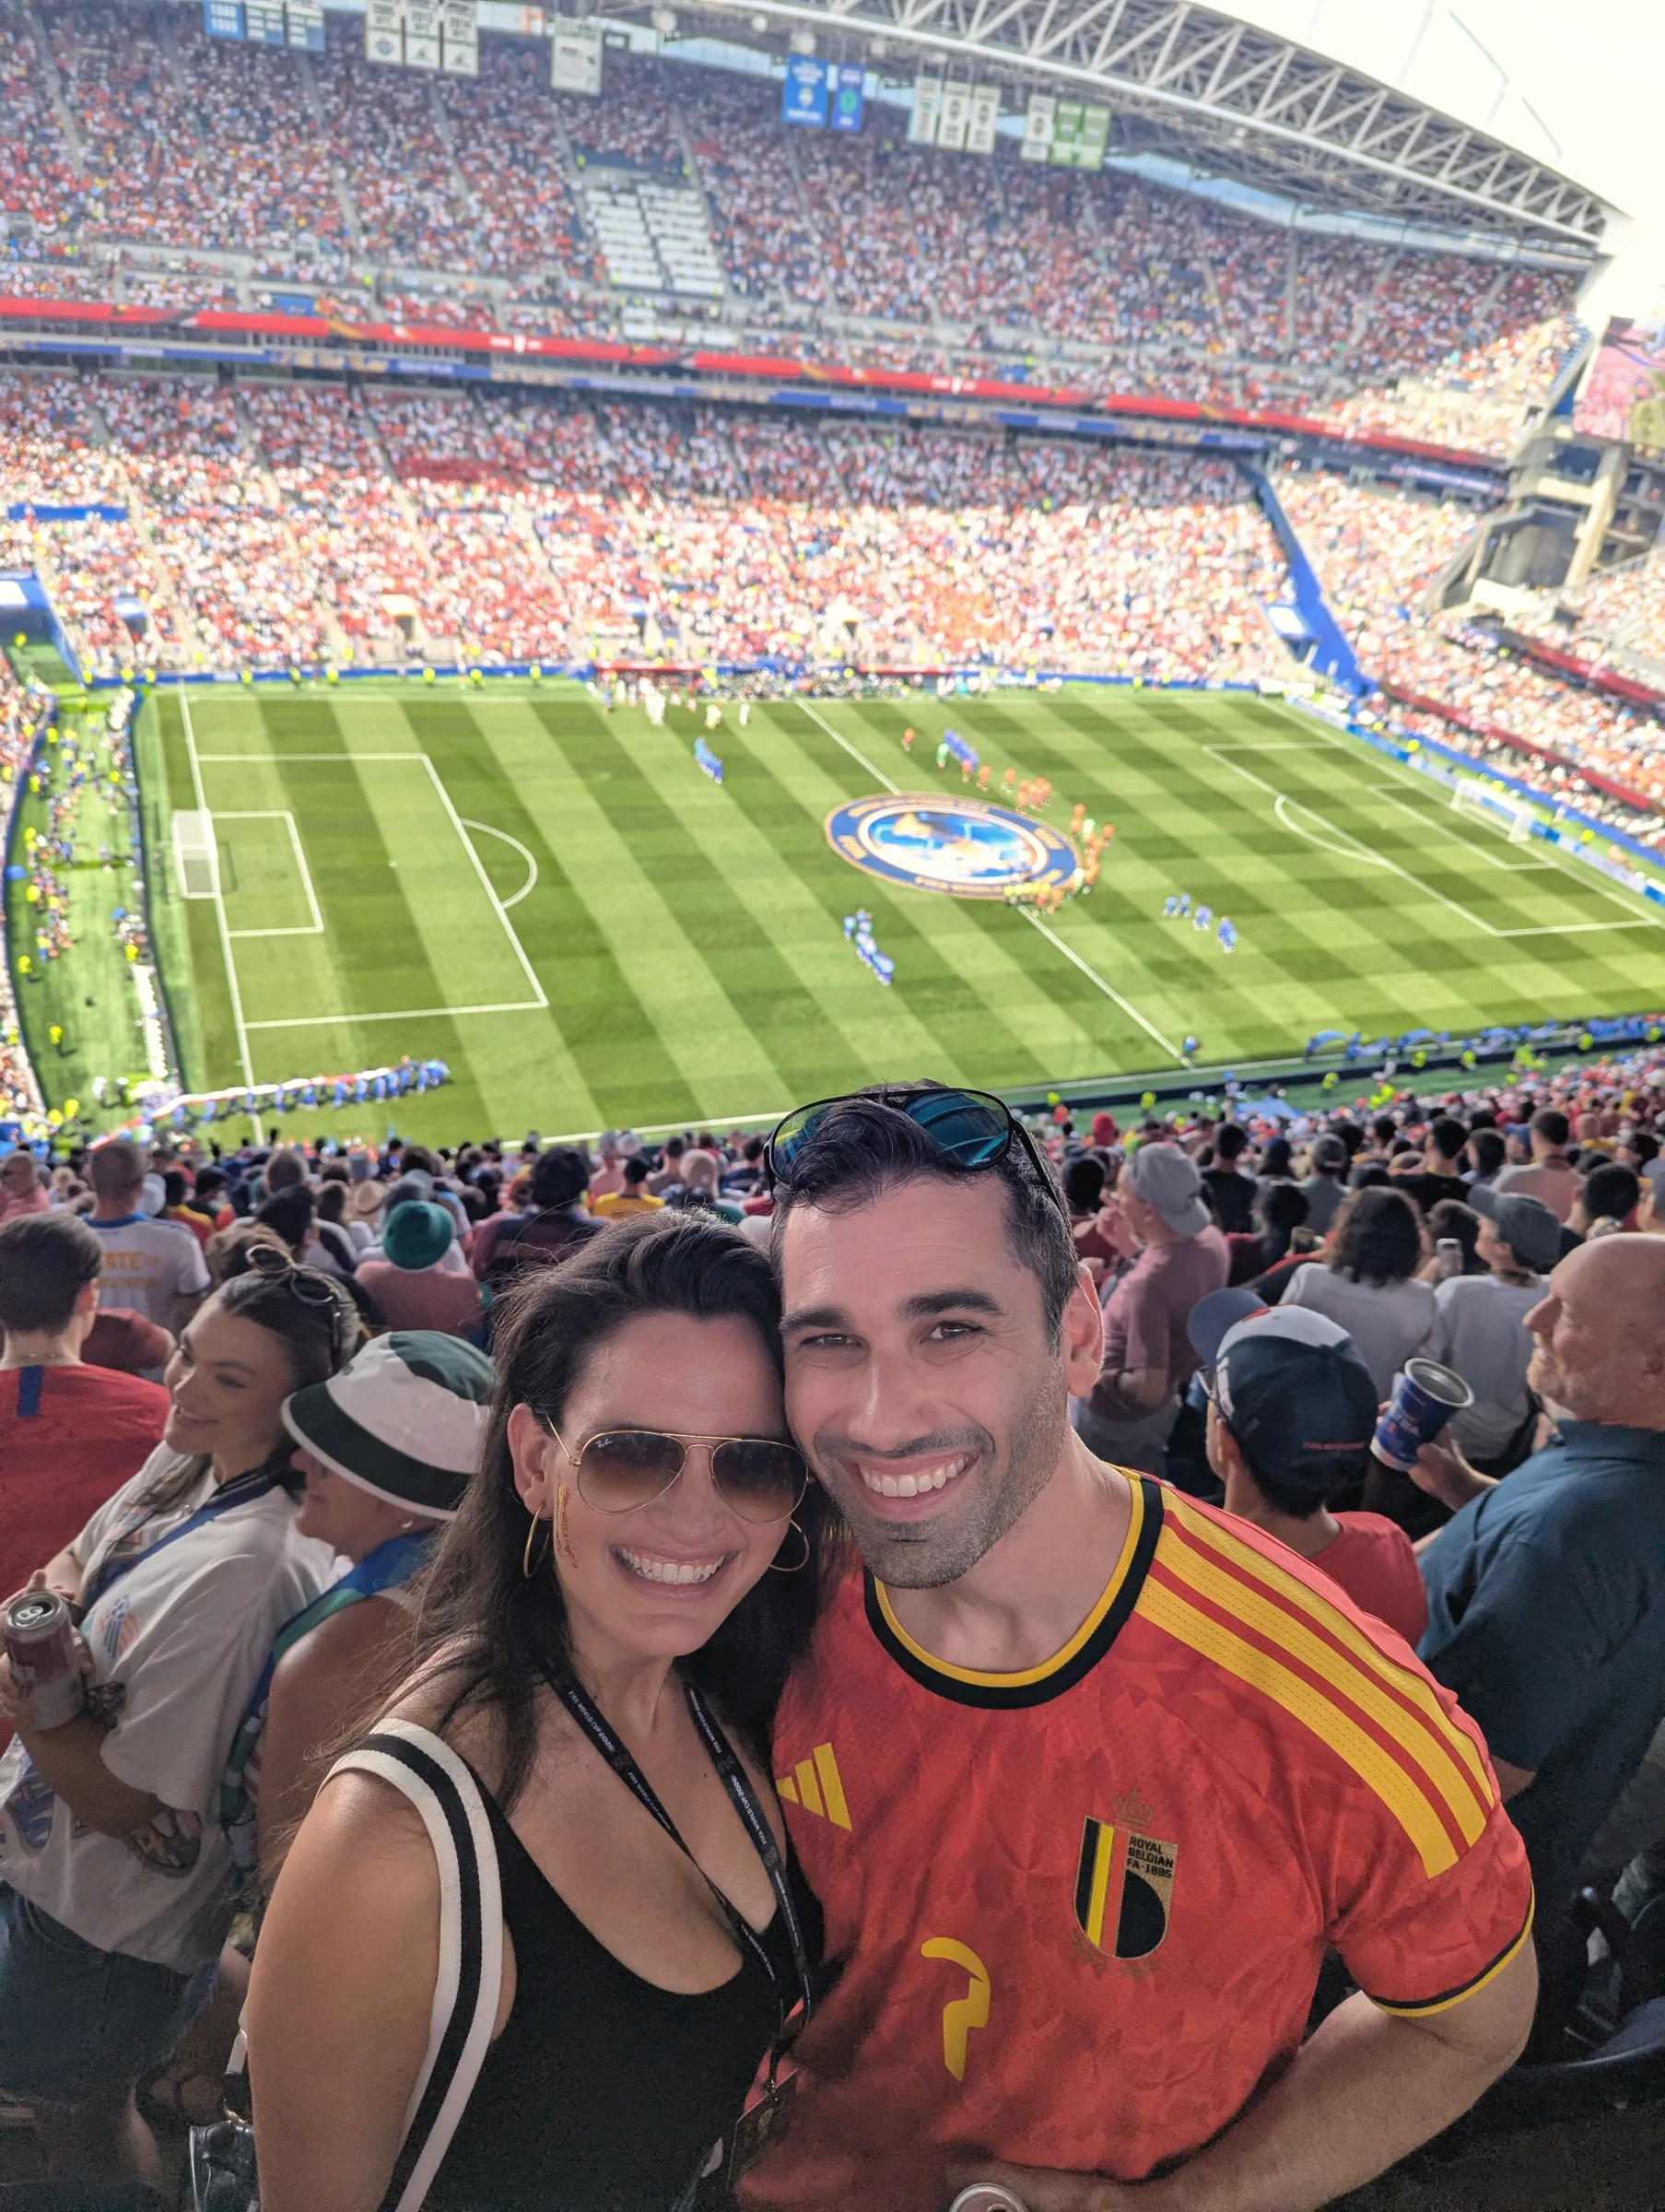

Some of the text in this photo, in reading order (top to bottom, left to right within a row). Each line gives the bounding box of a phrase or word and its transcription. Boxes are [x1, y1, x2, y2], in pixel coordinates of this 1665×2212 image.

[577, 1702, 593, 1723] WORLD
[591, 1721, 602, 1733] CUP
[741, 1795, 750, 1809] CUP
[747, 1808, 760, 1831] WORLD
[1130, 1836, 1163, 1855] ROYAL
[1128, 1846, 1174, 1868] BELGIAN
